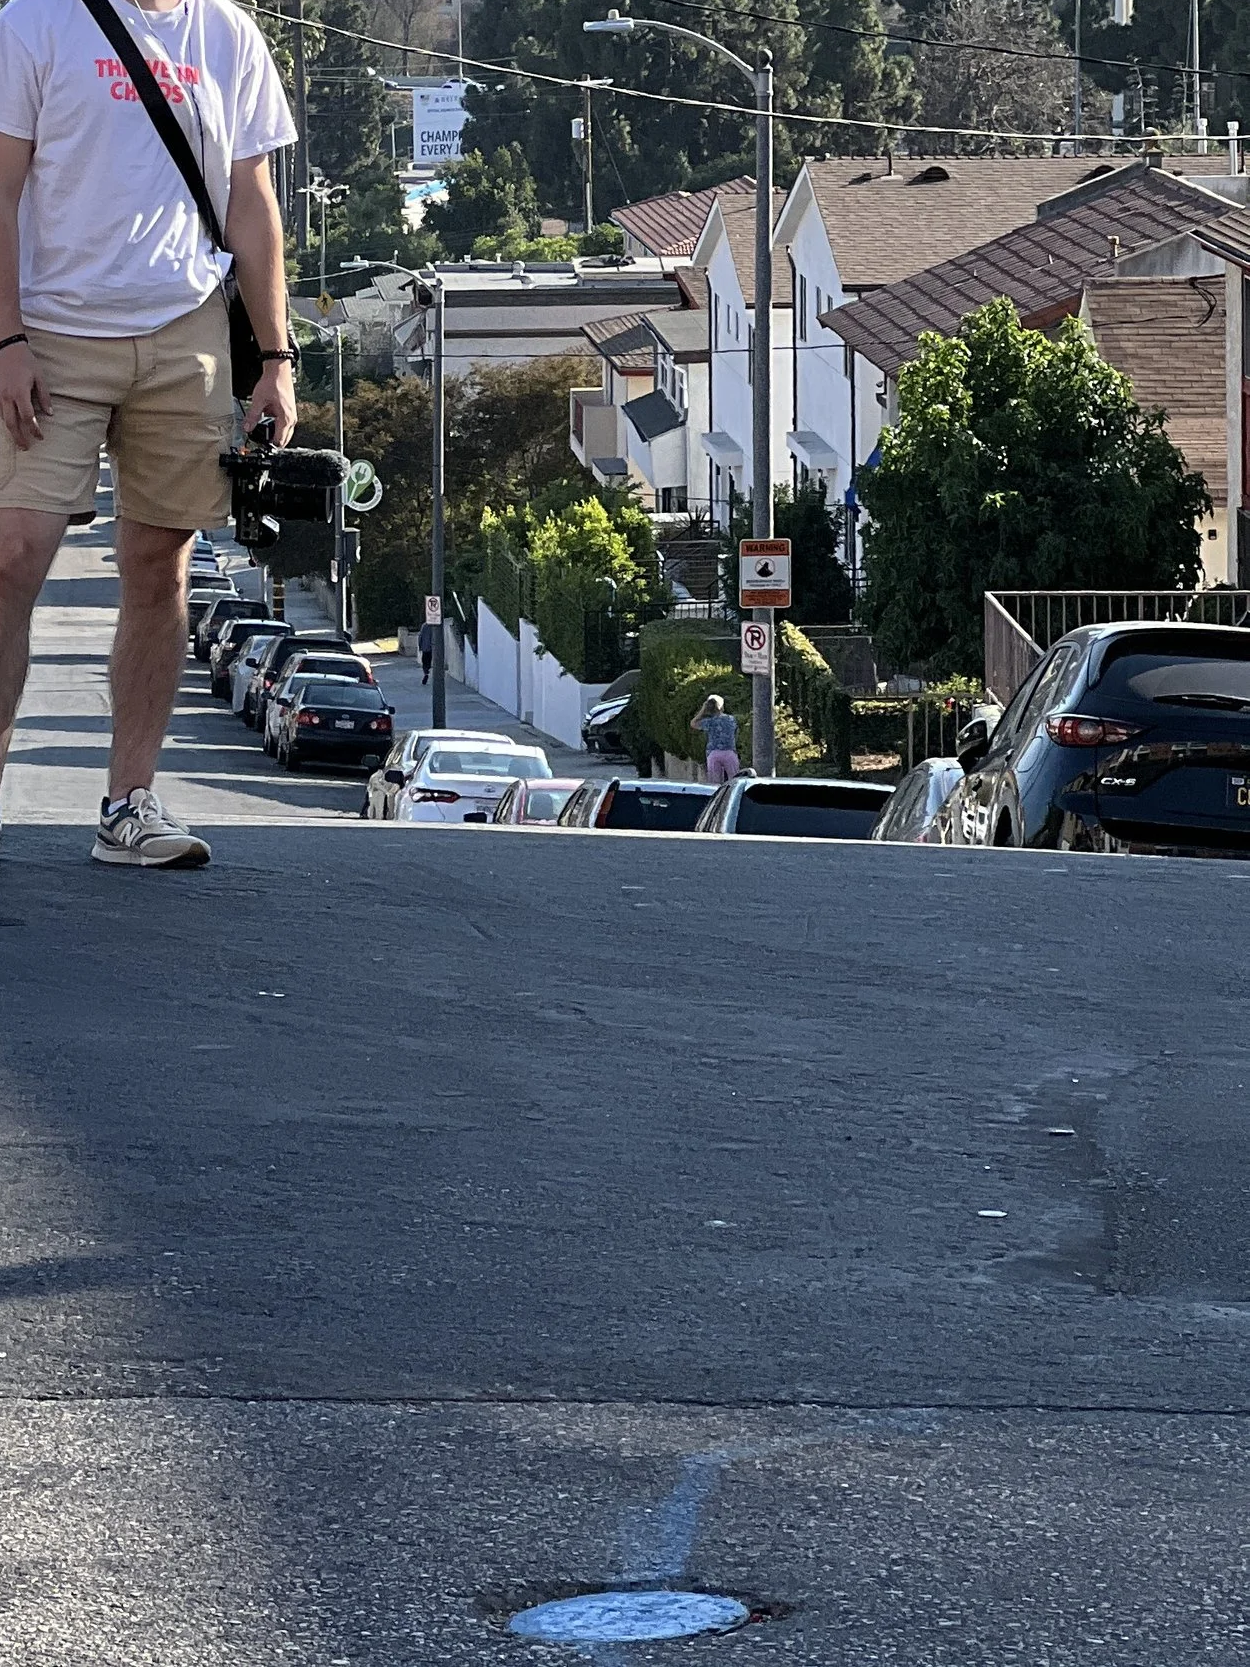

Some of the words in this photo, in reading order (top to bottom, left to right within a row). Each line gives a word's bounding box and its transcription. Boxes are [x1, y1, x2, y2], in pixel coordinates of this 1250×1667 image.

[94, 59, 171, 78] THVE
[110, 81, 184, 104] CHOS
[421, 143, 453, 156] EVERY
[746, 543, 786, 552] WARNING
